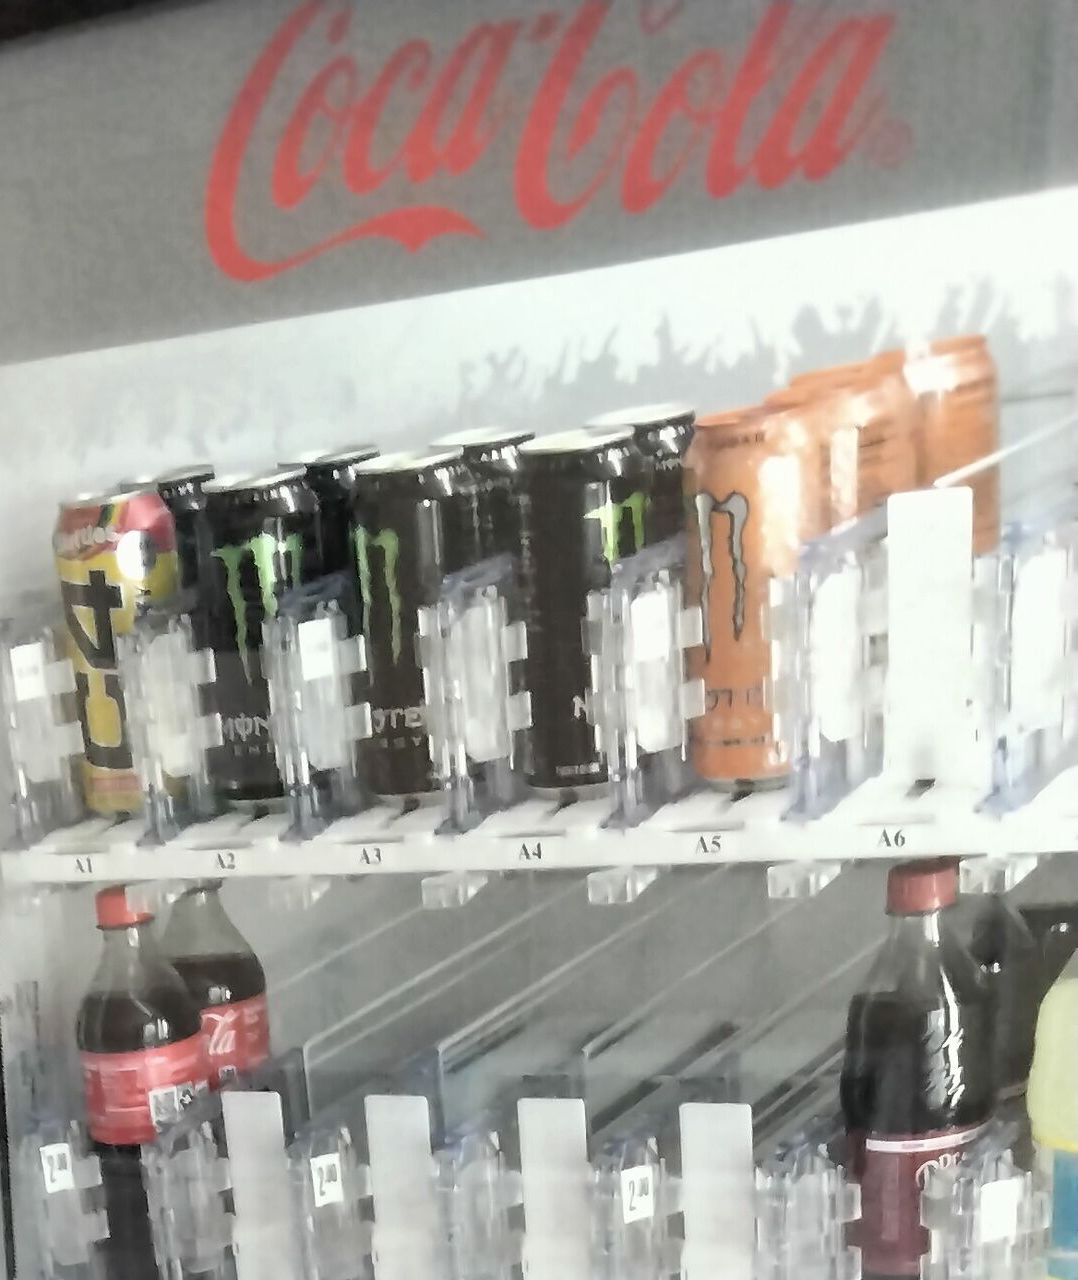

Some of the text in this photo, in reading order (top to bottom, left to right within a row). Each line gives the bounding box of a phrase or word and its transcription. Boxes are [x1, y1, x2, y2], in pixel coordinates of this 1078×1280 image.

[695, 836, 722, 854] A5
[878, 828, 906, 847] A6
[360, 848, 381, 864] A3
[519, 842, 541, 860] A4
[216, 853, 236, 870] A2
